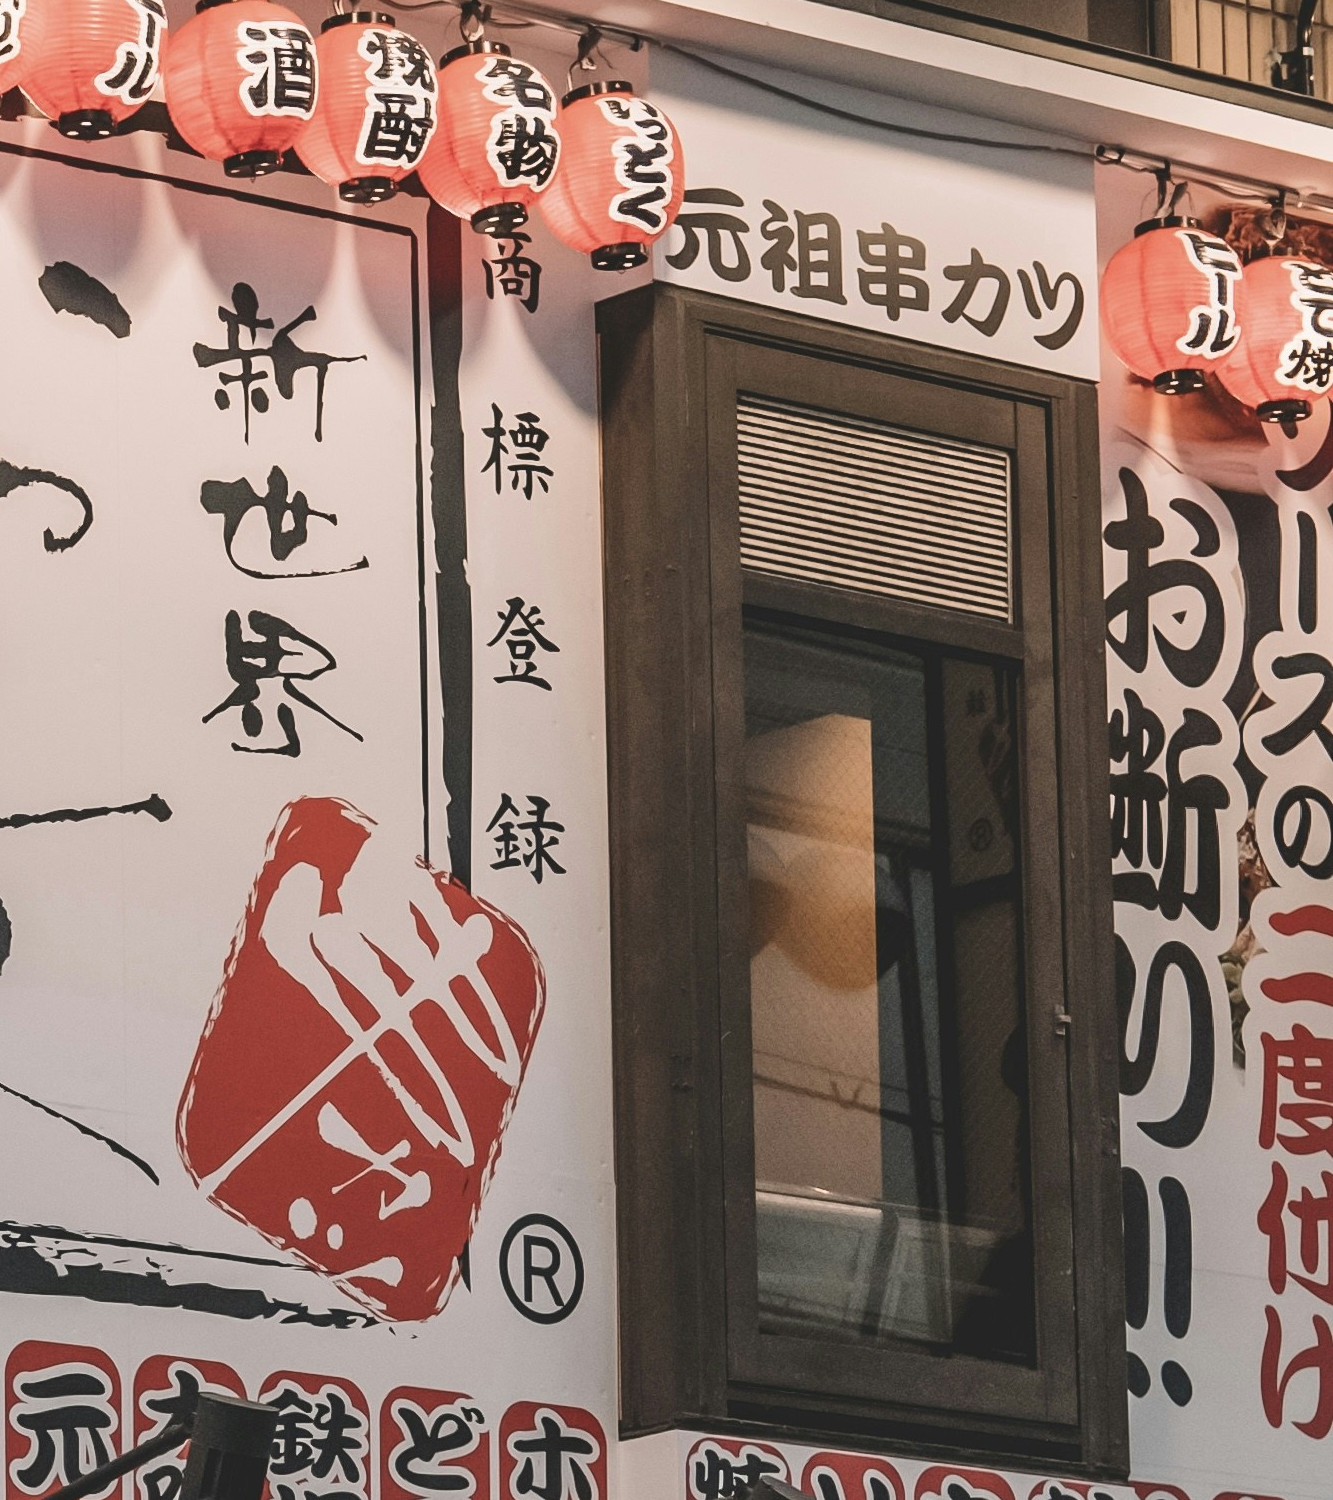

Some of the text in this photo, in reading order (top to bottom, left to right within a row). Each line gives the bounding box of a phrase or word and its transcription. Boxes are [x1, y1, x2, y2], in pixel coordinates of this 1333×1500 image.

[244, 25, 316, 112] 酒
[363, 30, 437, 164] 焼酎
[486, 58, 560, 186] 名物
[603, 100, 671, 229] いっとく
[664, 187, 1085, 350] 元祖串カツ
[193, 283, 369, 758] 新世界
[480, 224, 568, 884] 商標登録
